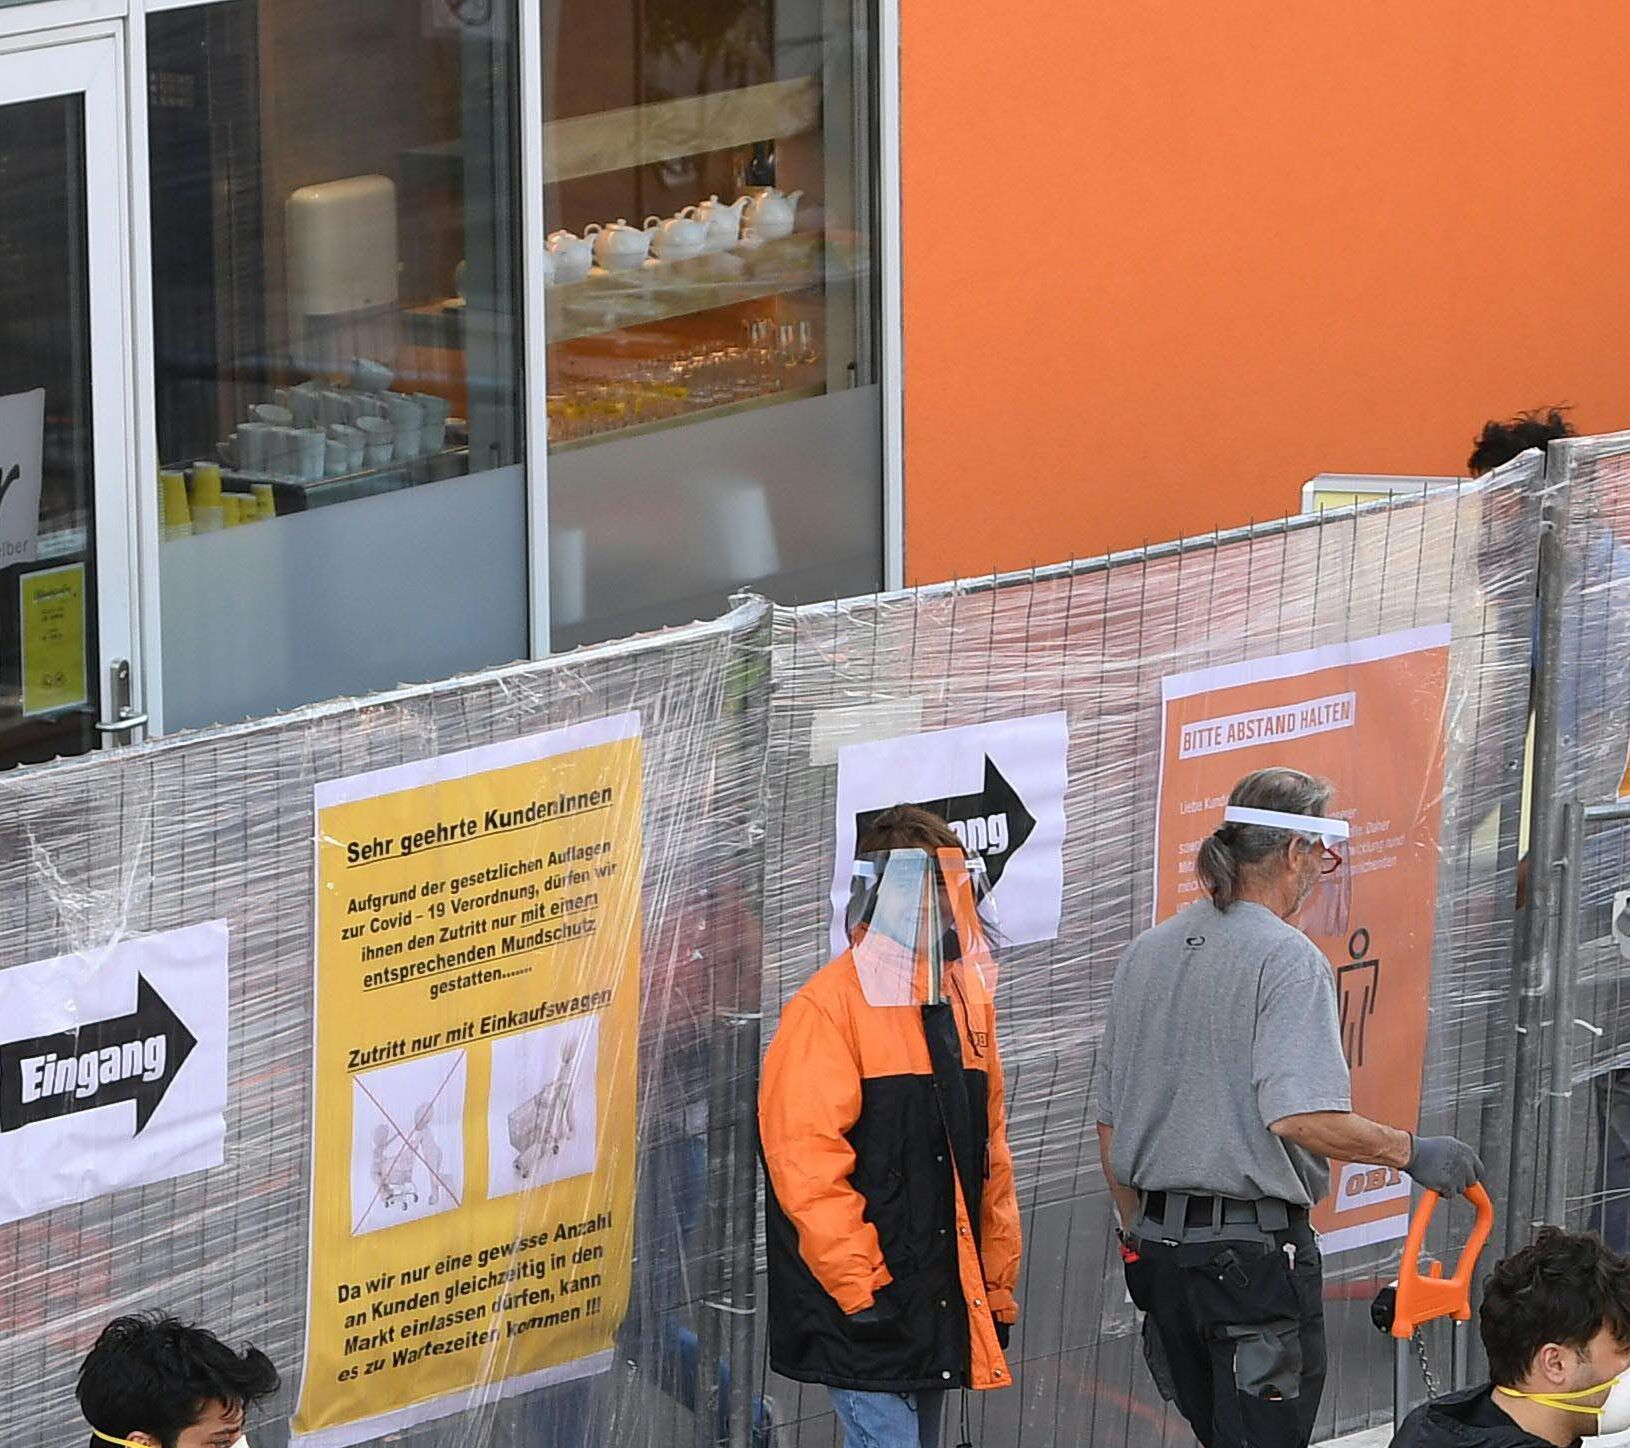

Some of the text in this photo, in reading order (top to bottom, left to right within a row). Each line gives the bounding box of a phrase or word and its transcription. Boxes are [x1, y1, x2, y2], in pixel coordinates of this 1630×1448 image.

[1183, 701, 1351, 752] BITTE ABSTAND HALTEN
[347, 786, 612, 863] Sehr geehrte KundenInnen
[341, 923, 365, 941] zur
[370, 909, 412, 933] Covid
[428, 902, 446, 920] 19
[451, 884, 540, 914] Verordnung,
[544, 869, 591, 892] dürfen
[595, 861, 617, 879] wir
[347, 841, 612, 914] Aufgrund der gesetzlichen Auflagen
[361, 892, 598, 963] ihnen den Zutritt nur mit einem
[363, 918, 597, 987] entsprechenden Mundschutz
[348, 988, 613, 1069] Zutritt nur mit Einkaufswagen
[20, 1034, 166, 1104] Eingang
[1345, 1166, 1402, 1197] OBI
[338, 1284, 361, 1304] Da
[365, 1273, 396, 1294] wir
[400, 1265, 431, 1286] nur
[435, 1254, 472, 1275] eine
[553, 1211, 612, 1242] Anzahl
[344, 1244, 603, 1329] an Kunden gleichzeitig in den
[337, 1366, 358, 1382] es
[364, 1358, 386, 1376] zu
[392, 1328, 500, 1368] Wartezeiten
[506, 1305, 580, 1338] kommen
[344, 1272, 602, 1356] Markt einlassen dürfen, kann
